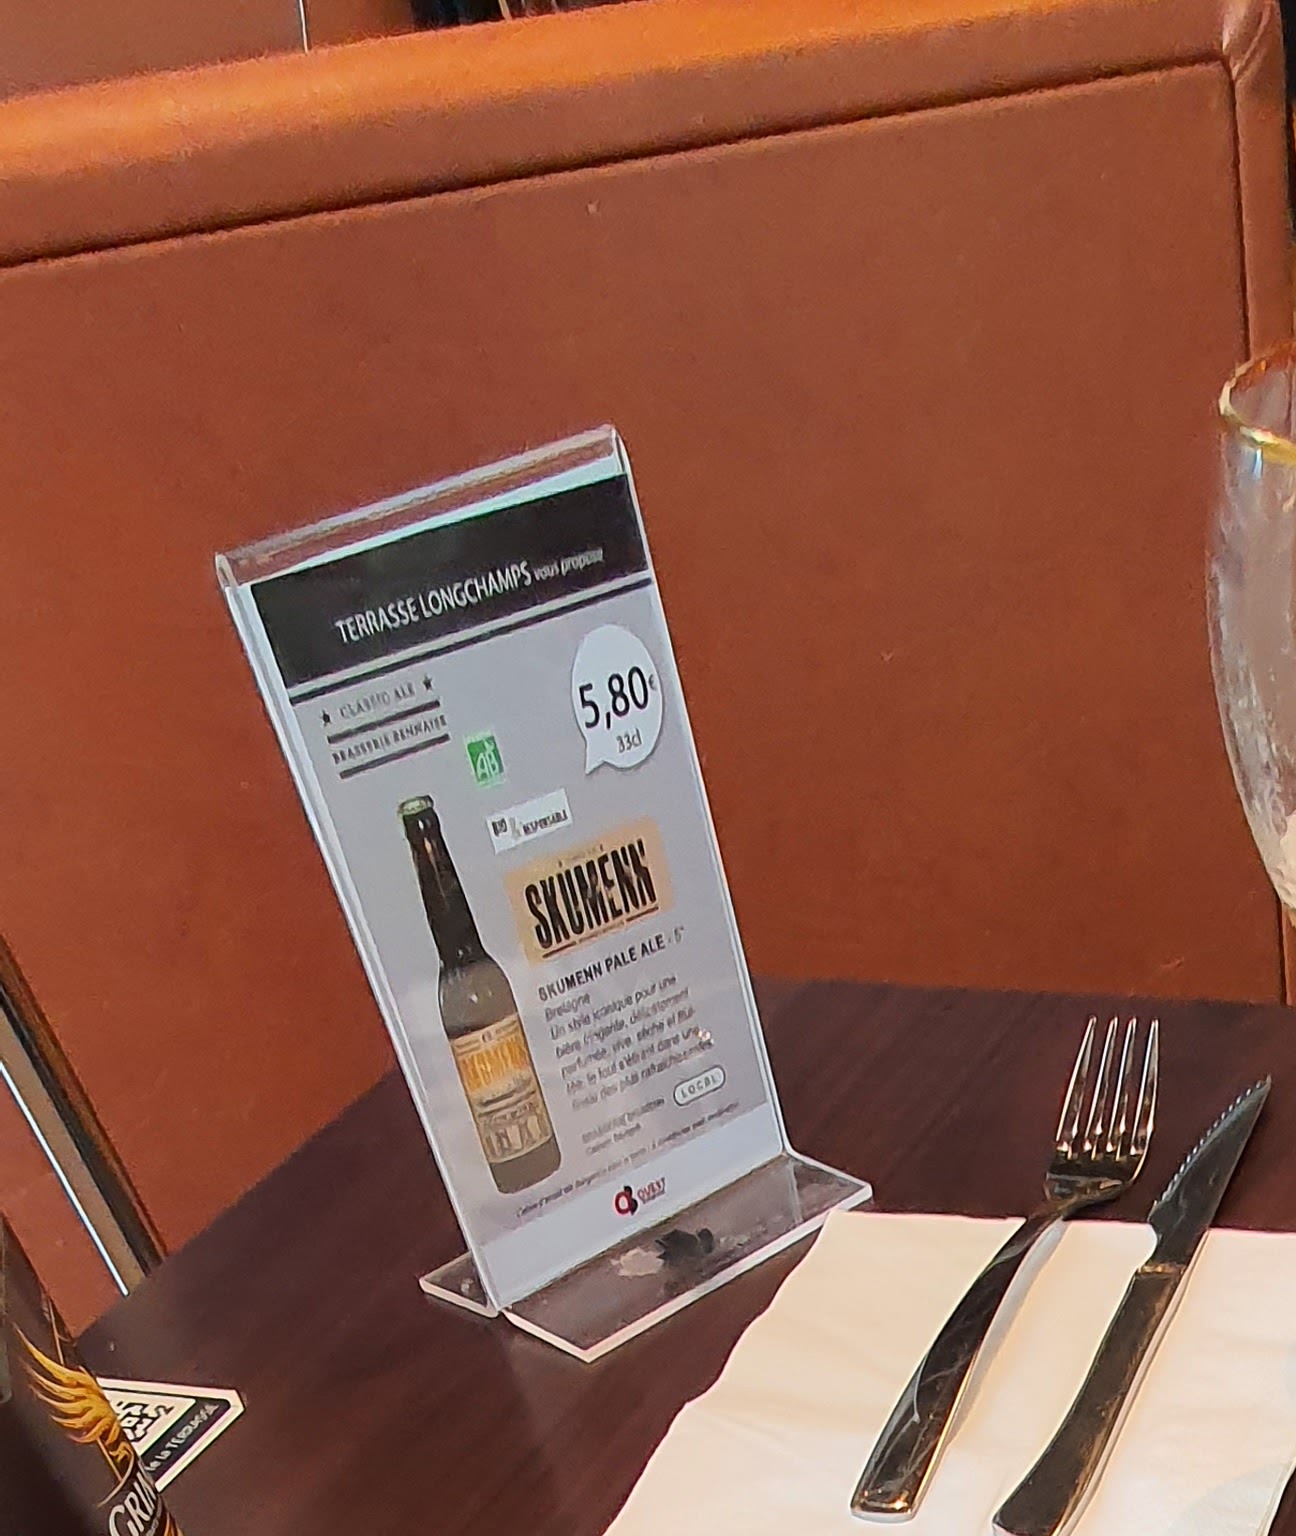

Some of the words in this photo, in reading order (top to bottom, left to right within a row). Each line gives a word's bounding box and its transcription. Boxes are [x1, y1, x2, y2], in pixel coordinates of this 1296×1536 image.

[336, 598, 420, 644] TERRASSE
[418, 562, 532, 618] LONGCHAMPS
[534, 563, 559, 580] vous
[525, 838, 657, 949] SKUMENN
[538, 962, 603, 1003] SKUMENN
[605, 946, 638, 972] PALE
[640, 934, 664, 956] ALE
[635, 984, 657, 1002] pour
[681, 1073, 717, 1098] LOCAL
